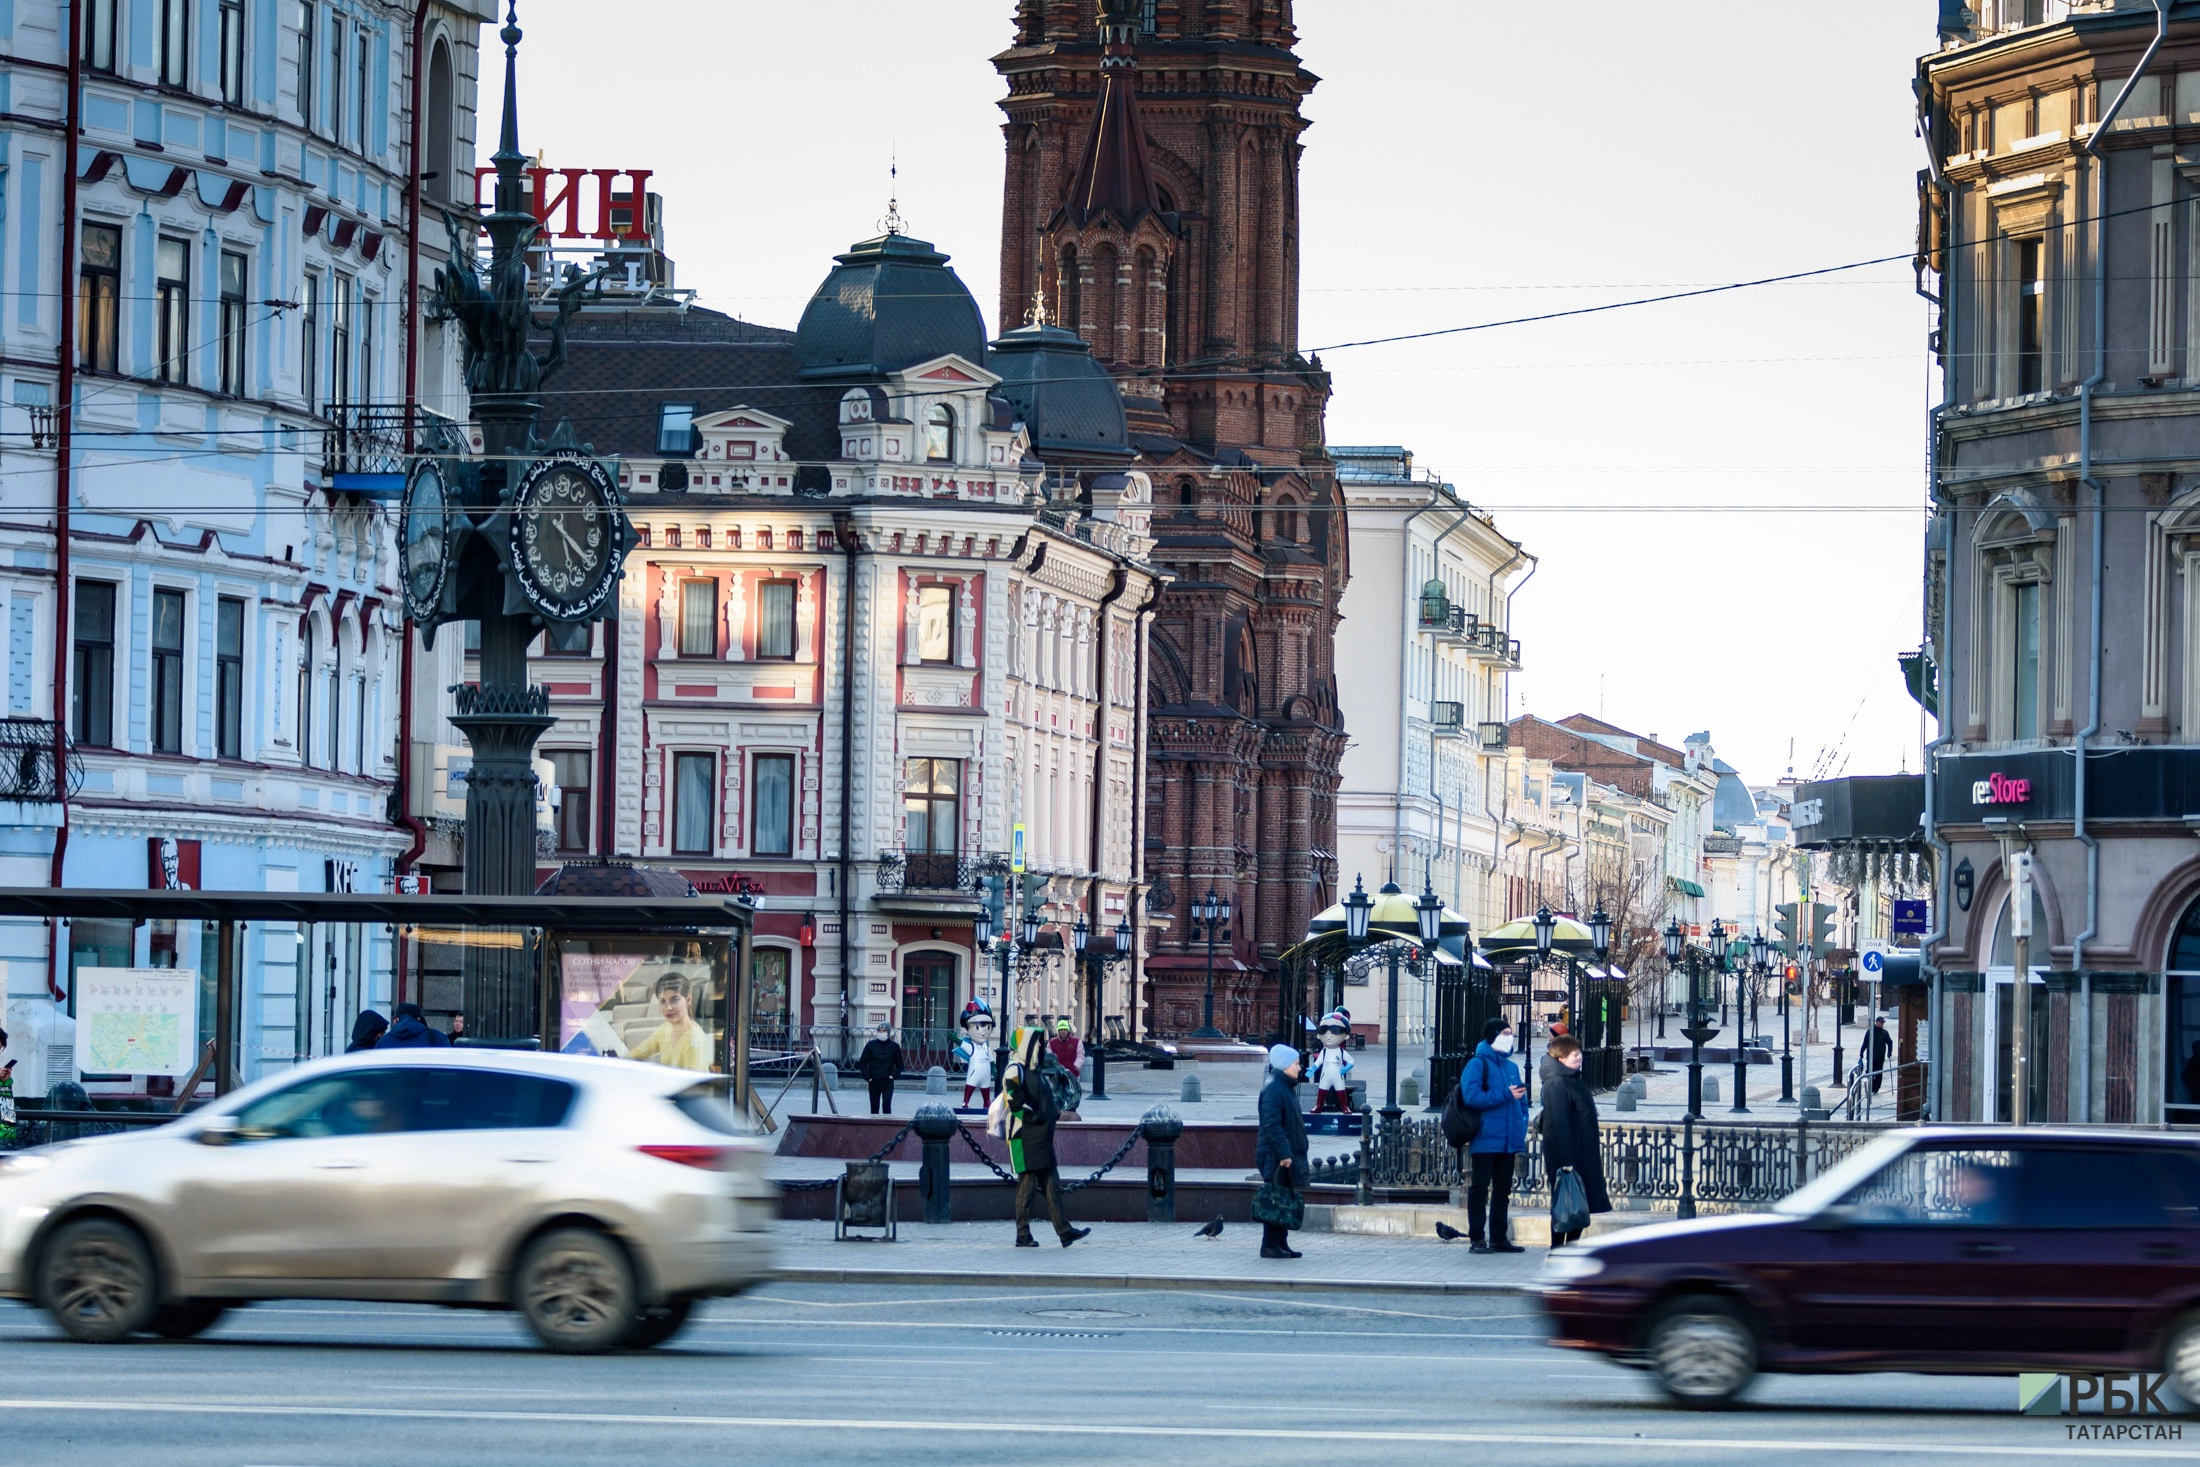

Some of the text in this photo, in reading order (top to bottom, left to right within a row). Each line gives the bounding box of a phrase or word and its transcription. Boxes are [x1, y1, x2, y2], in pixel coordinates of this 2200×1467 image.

[1973, 773, 2029, 804] re:Store
[332, 860, 359, 893] KFC
[692, 877, 765, 893] MILAVISA
[573, 957, 636, 966] СОТНИ ЧАСОВ
